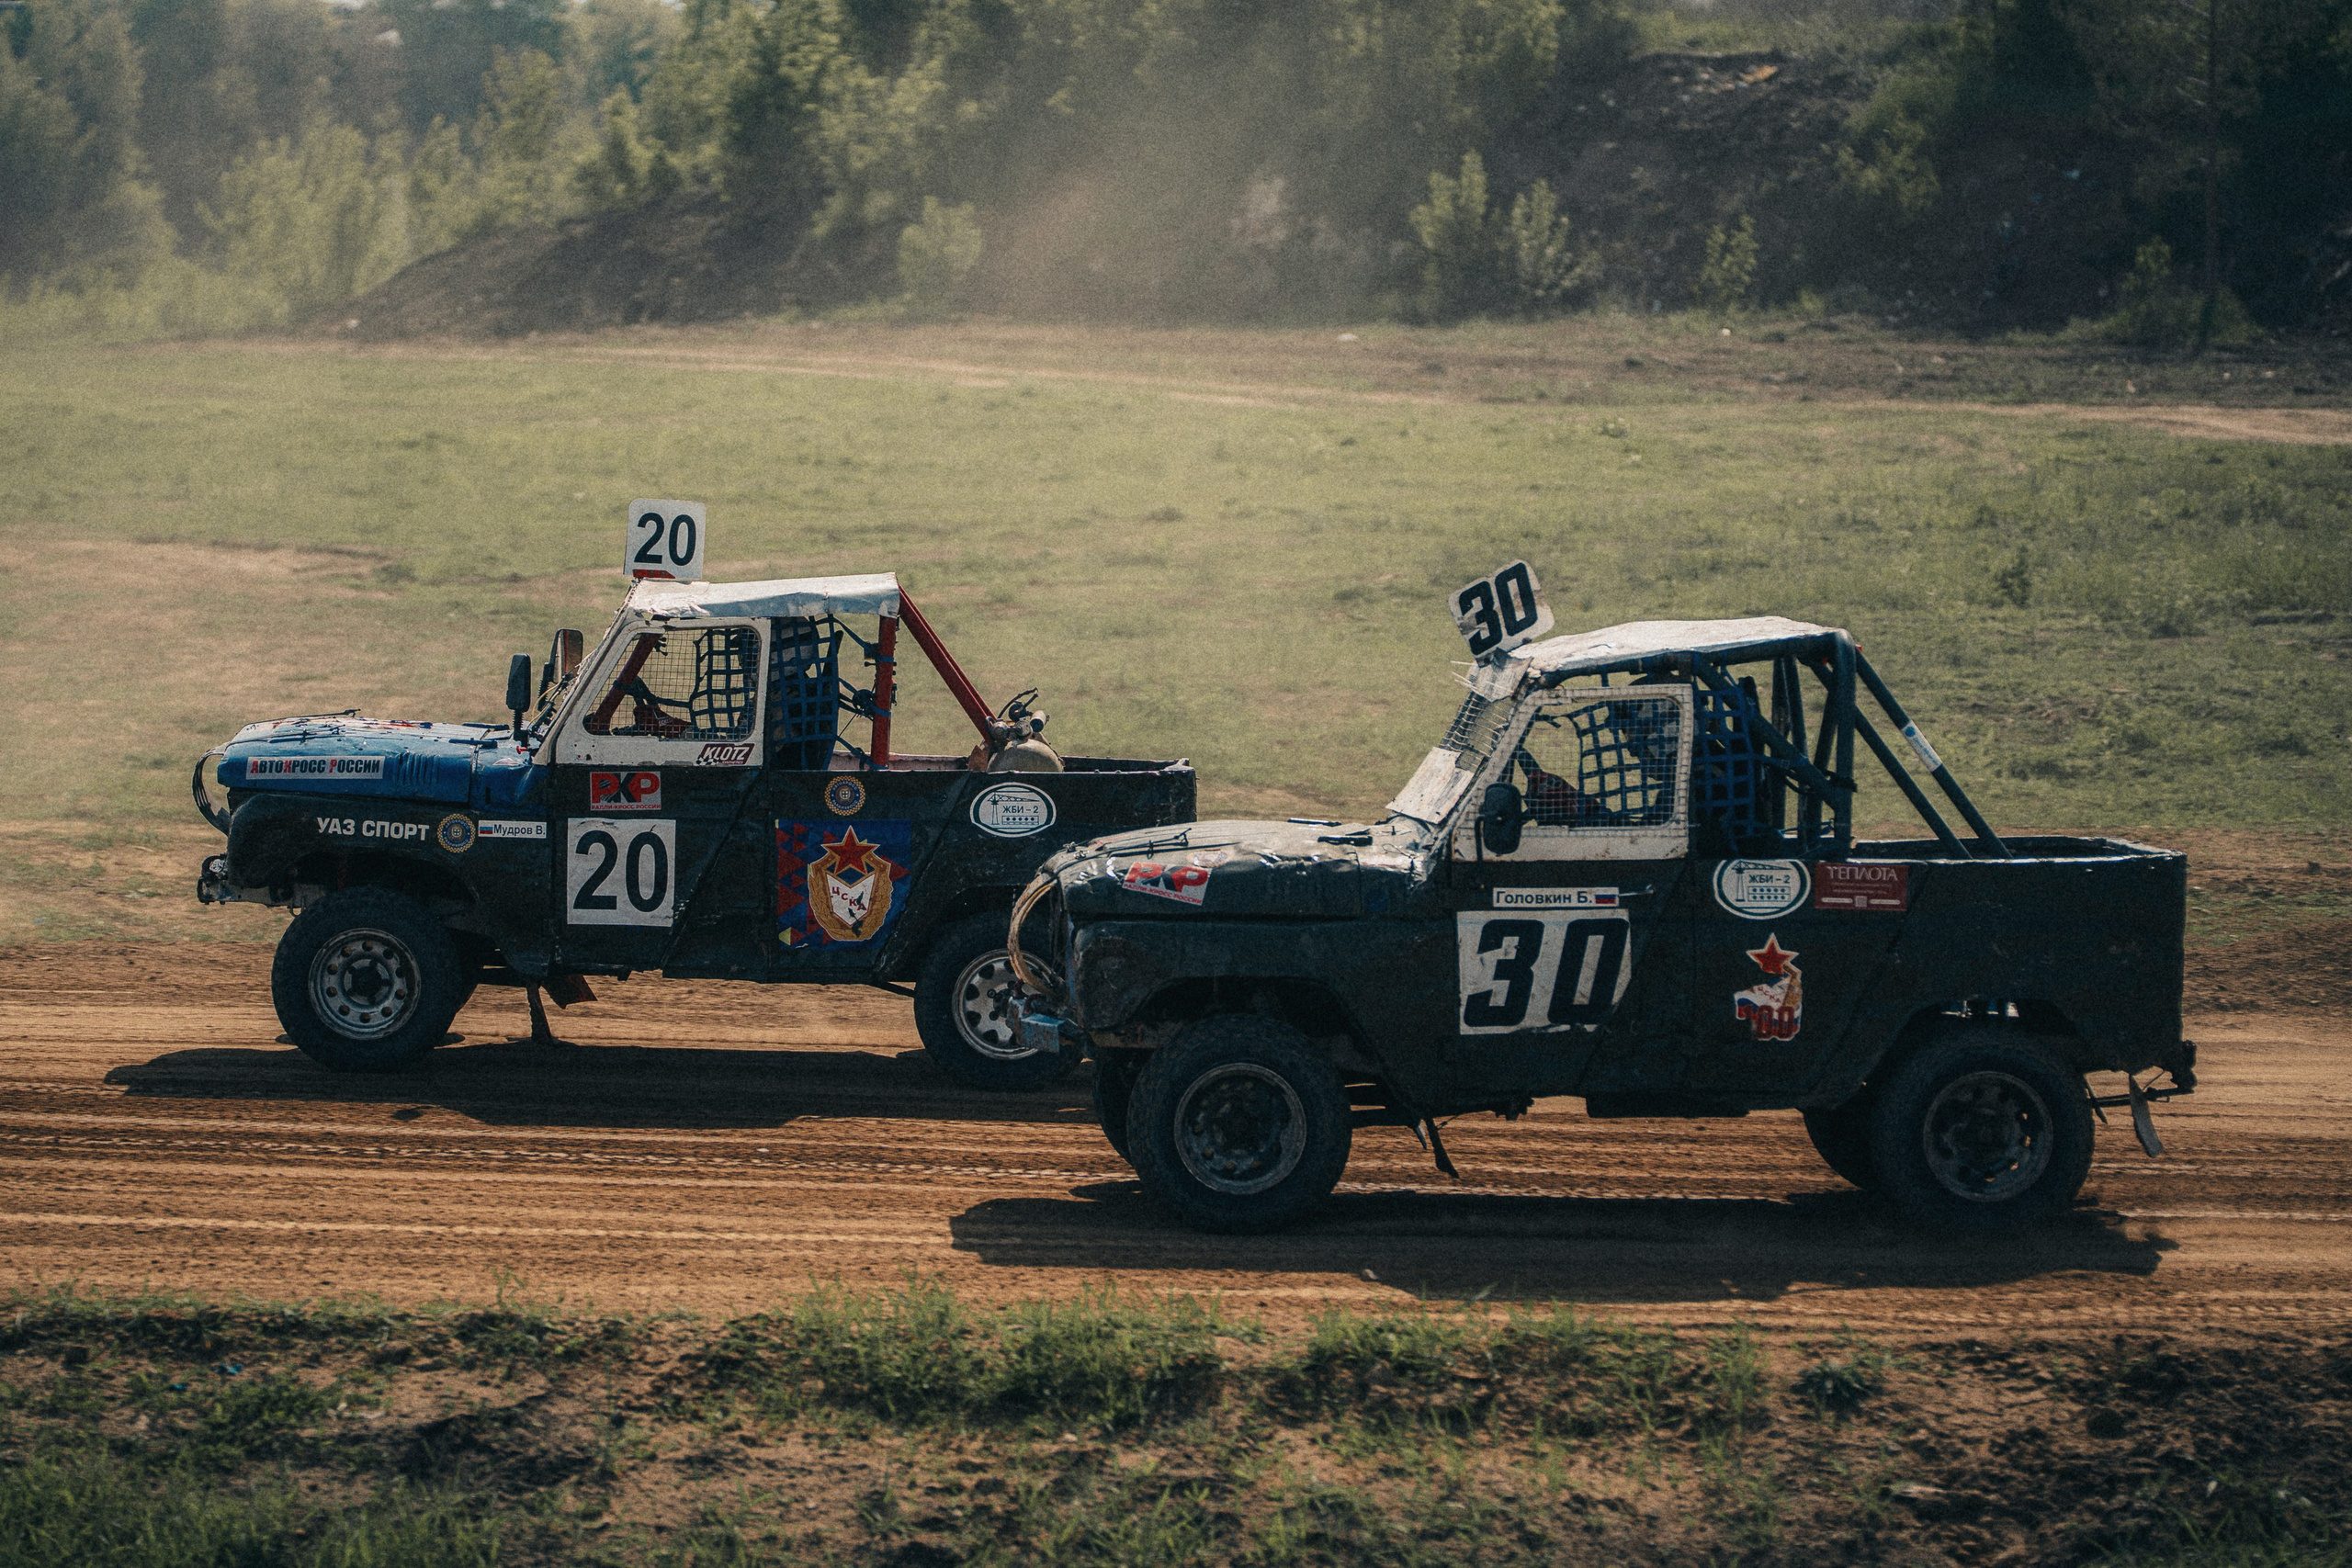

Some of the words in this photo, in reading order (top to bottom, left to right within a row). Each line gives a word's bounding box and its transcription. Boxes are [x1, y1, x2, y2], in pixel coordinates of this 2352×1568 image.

[634, 513, 696, 566] 20
[1459, 562, 1538, 655] 30
[703, 747, 749, 761] KLOTZ
[251, 760, 326, 773] АВТОКРОСС
[329, 759, 380, 773] РОССИИ
[1002, 806, 1024, 814] ЖБИ
[1034, 806, 1039, 814] 2
[317, 818, 355, 835] УАЗ
[362, 820, 429, 840] СПОРТ
[493, 824, 533, 836] Мудров
[536, 826, 546, 835] В.
[572, 829, 668, 912] 20
[1826, 866, 1898, 881] ТЕПЛОТА
[1748, 874, 1773, 884] ЖБИ
[1784, 874, 1791, 884] 2
[831, 886, 866, 911] ЦСКА
[1496, 891, 1572, 904] Головкин
[1577, 891, 1592, 904] Б.
[1464, 918, 1629, 1027] 30
